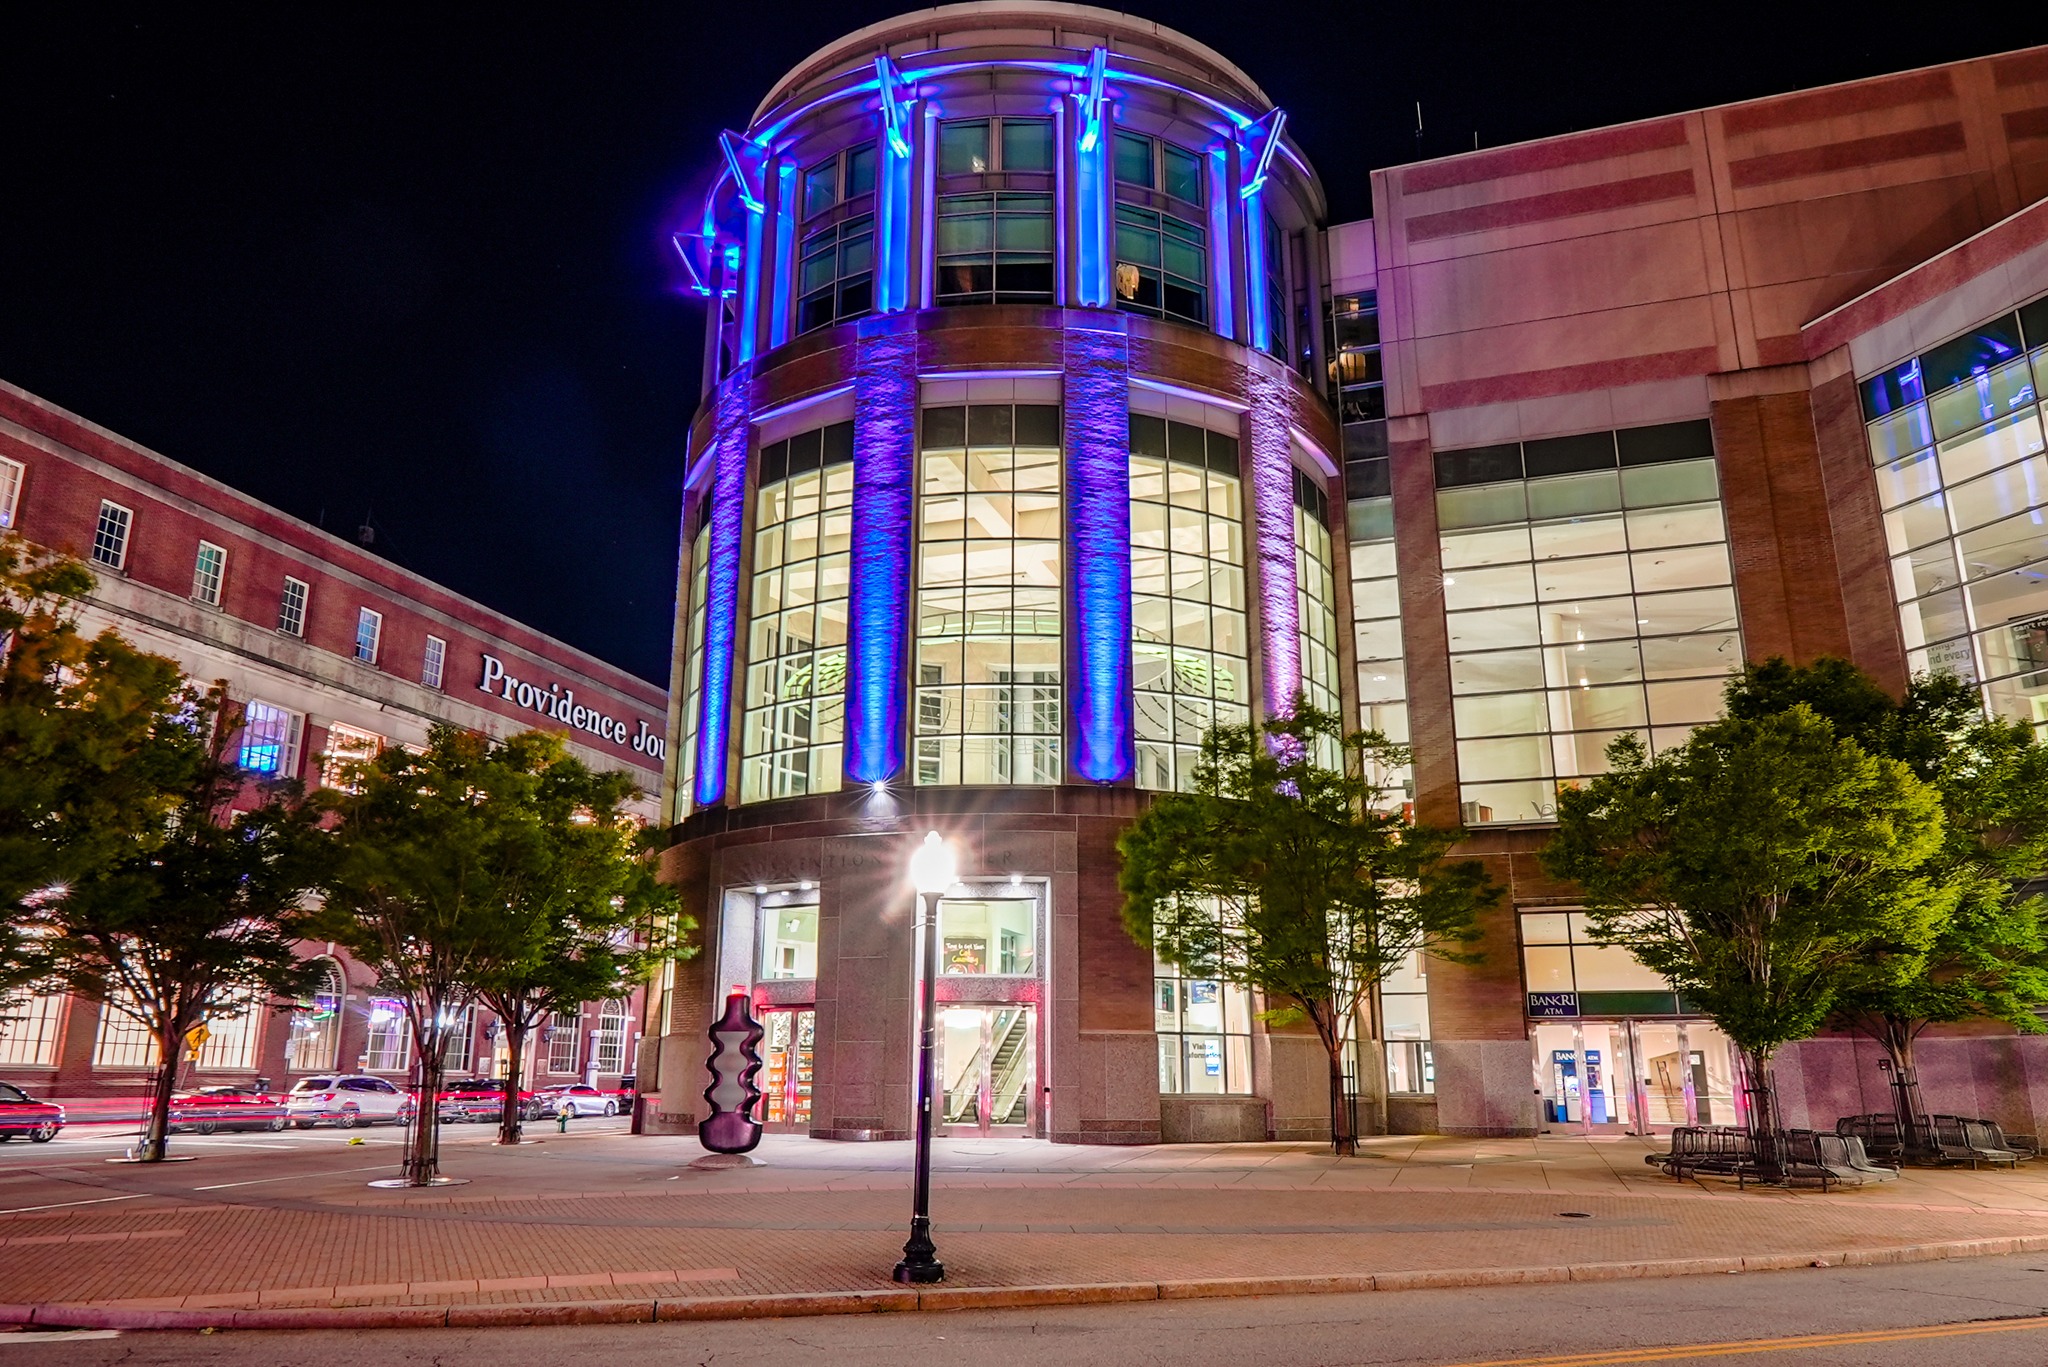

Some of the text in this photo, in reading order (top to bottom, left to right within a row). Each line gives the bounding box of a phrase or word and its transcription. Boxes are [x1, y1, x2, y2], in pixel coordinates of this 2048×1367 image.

[1943, 649, 1971, 662] every
[479, 653, 628, 746] Providence
[1543, 1007, 1564, 1015] ATM
